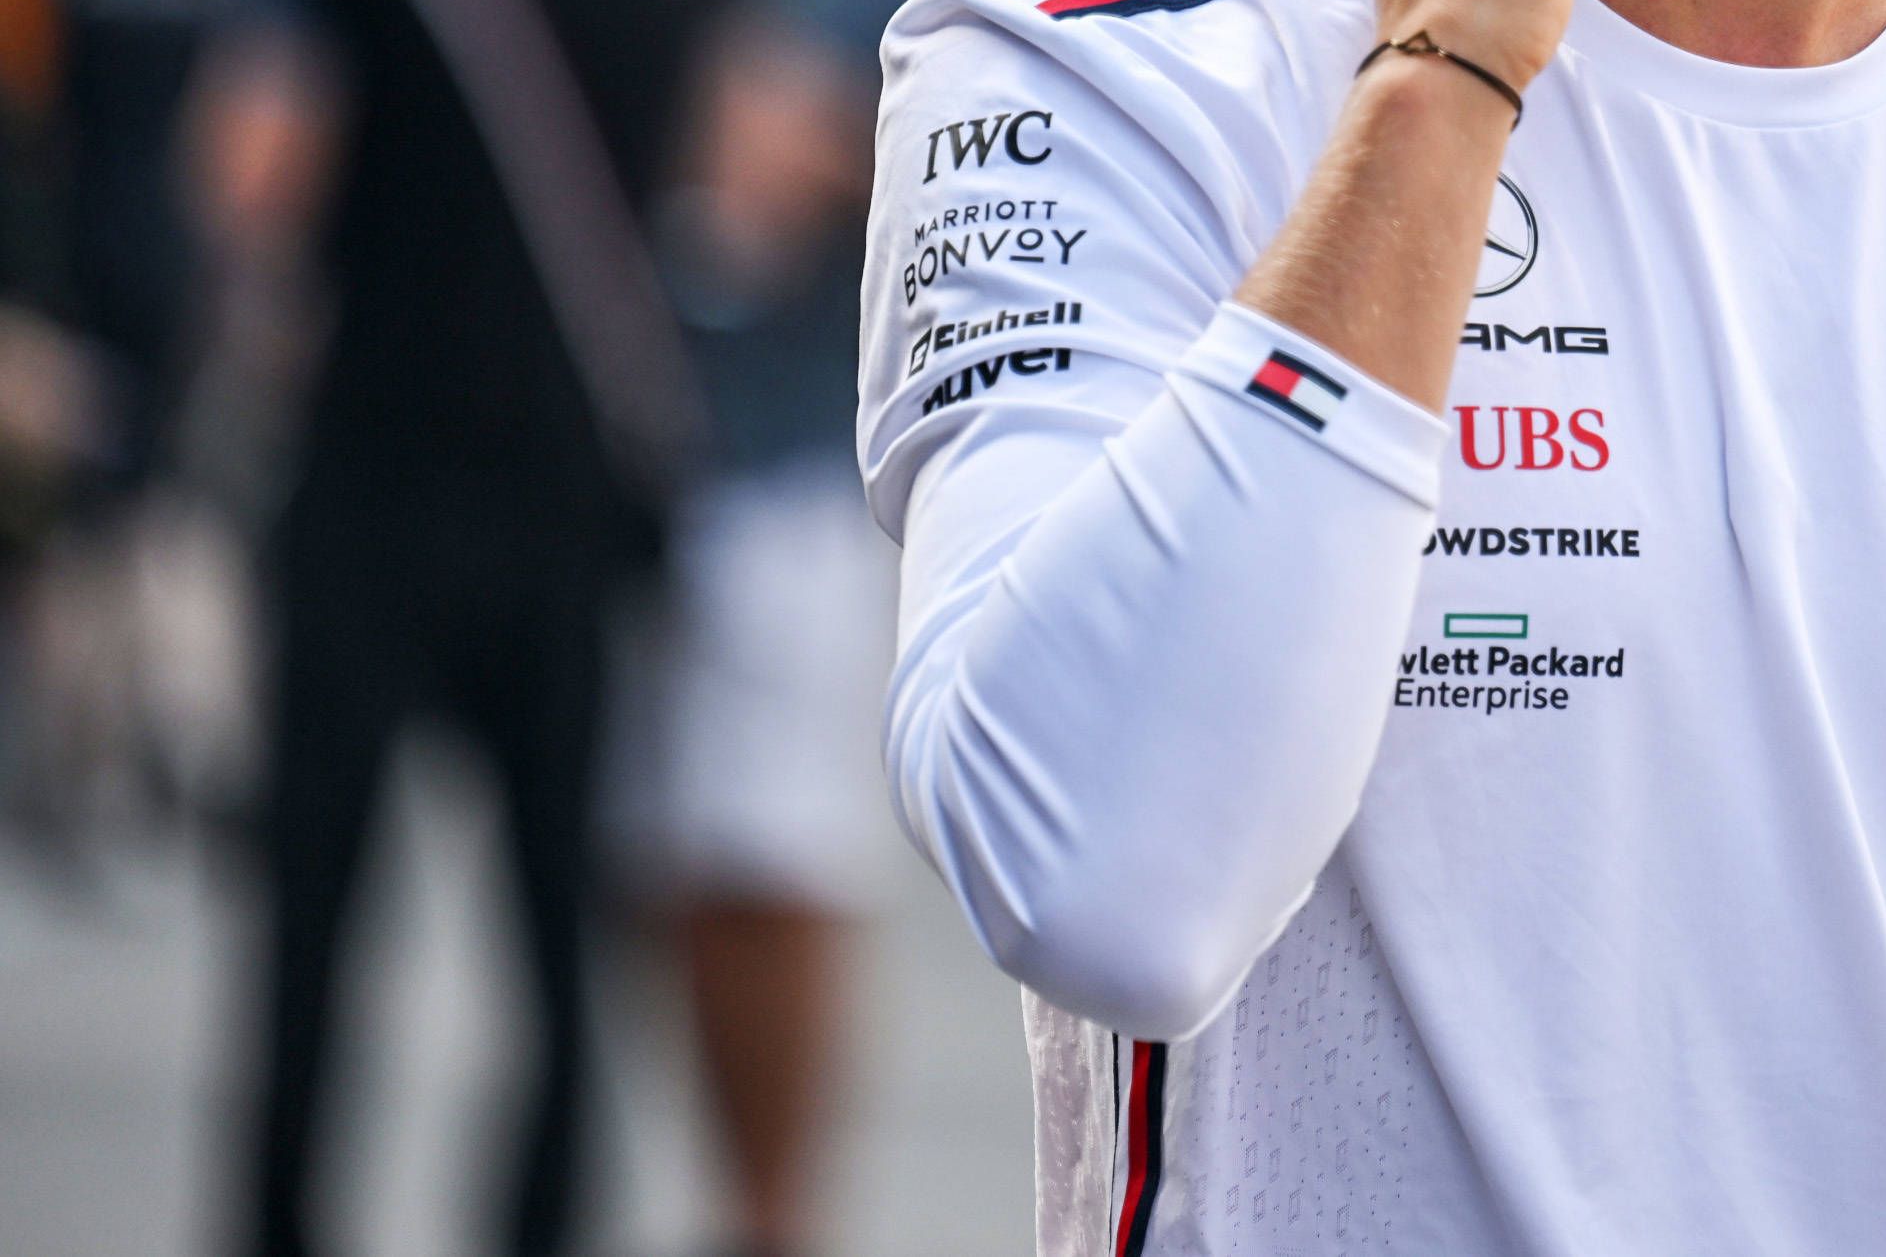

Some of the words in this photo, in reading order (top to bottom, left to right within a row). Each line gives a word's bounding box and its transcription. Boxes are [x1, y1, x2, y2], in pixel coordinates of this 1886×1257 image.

[923, 110, 1052, 184] IWC
[914, 200, 1058, 246] MARRIOTT
[904, 228, 1087, 307] BONVOY
[934, 302, 1081, 352] Einhell
[1460, 323, 1609, 355] AMG
[1452, 406, 1610, 472] UBS
[1487, 646, 1624, 678] Packard
[1394, 678, 1569, 715] Enterprise
